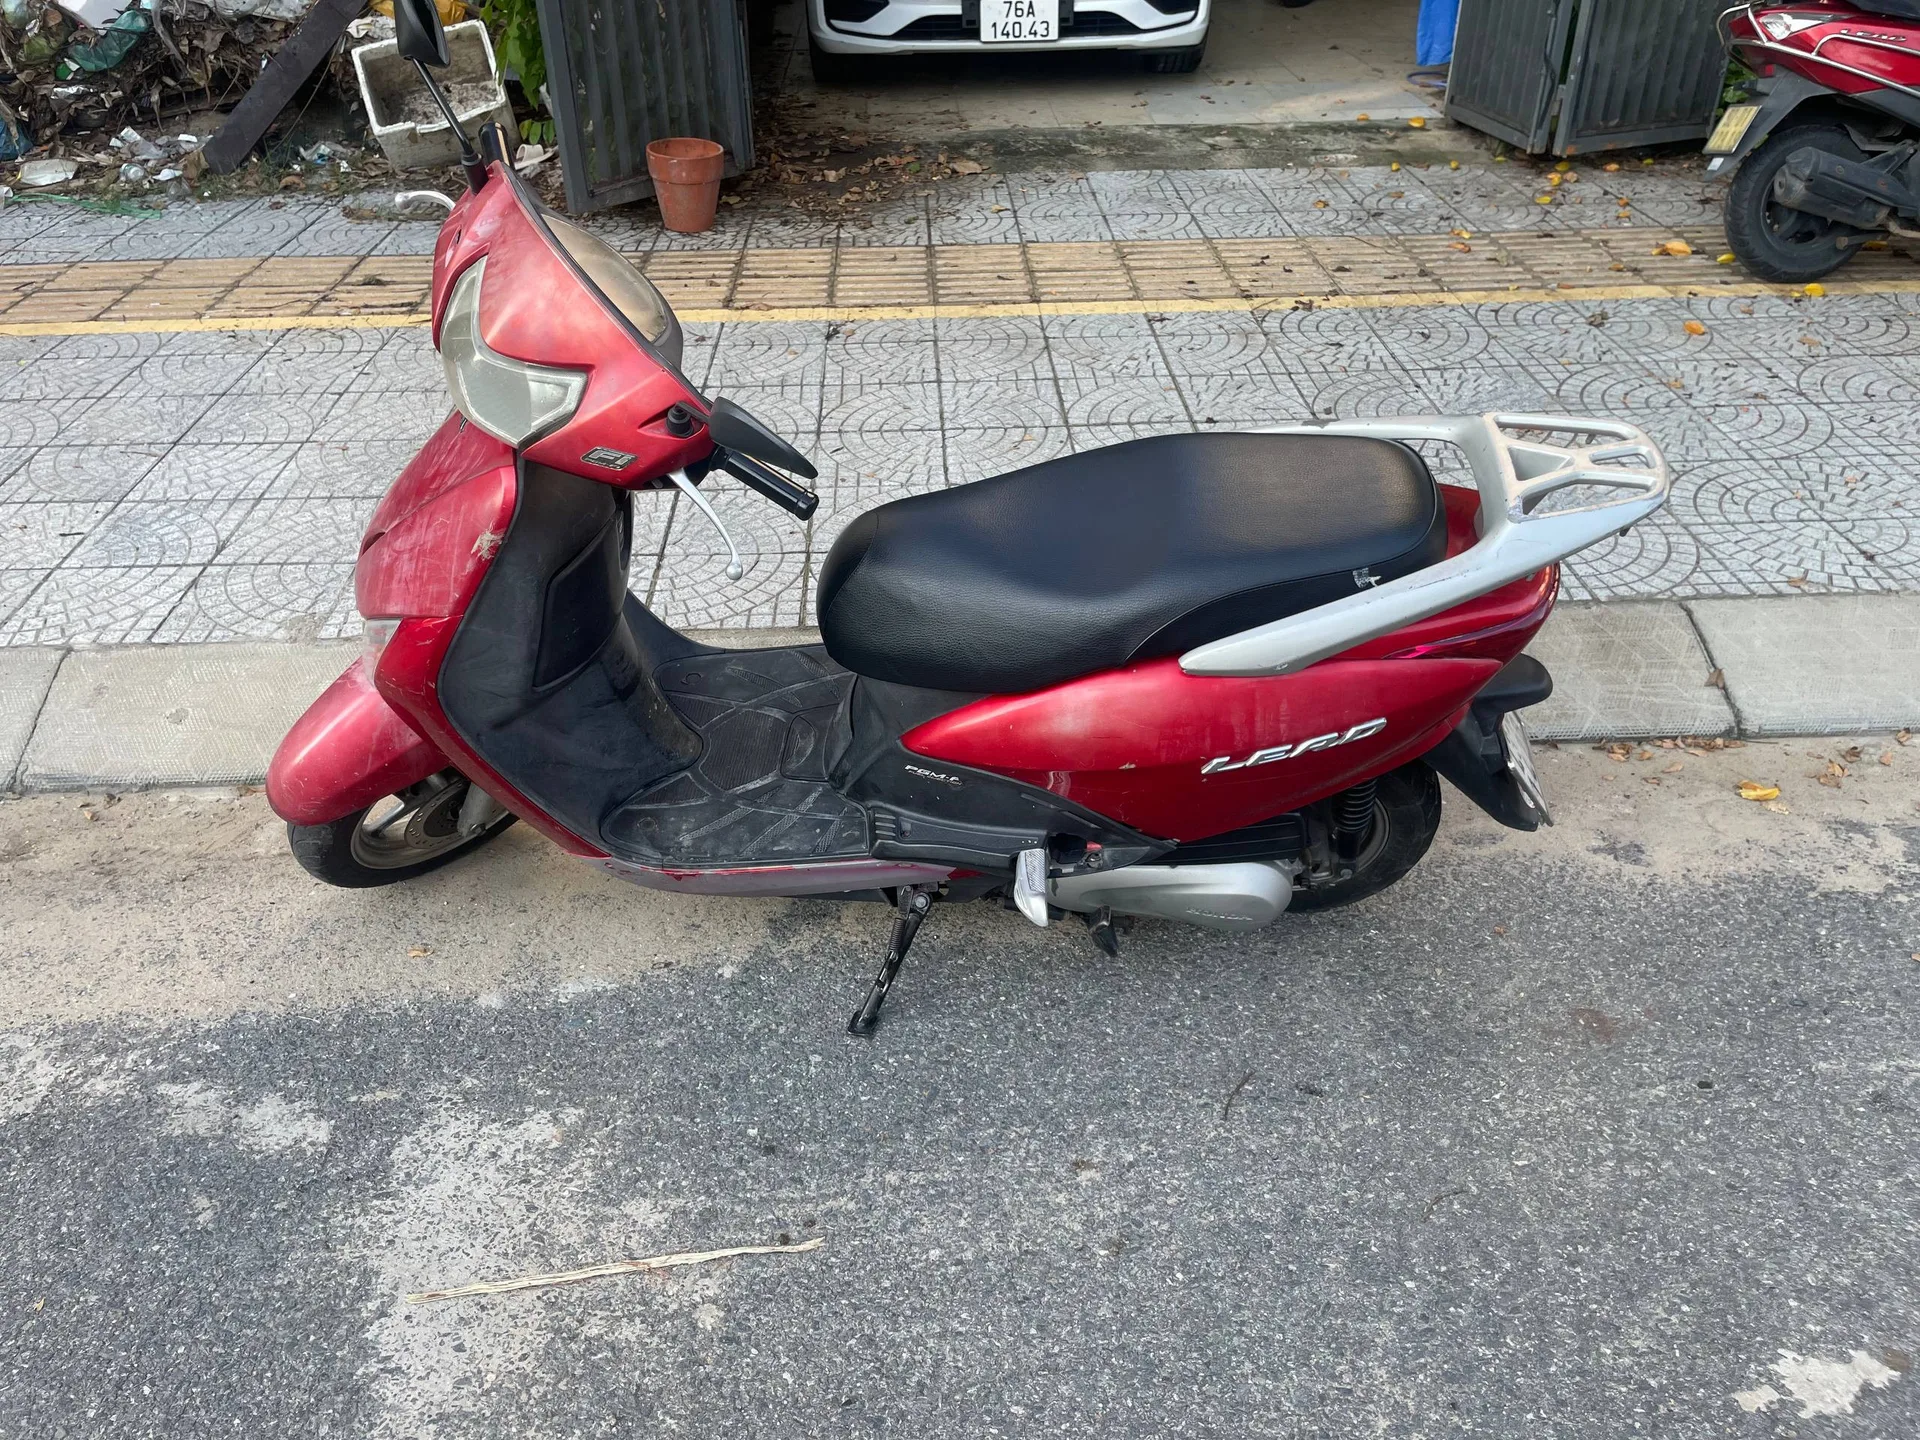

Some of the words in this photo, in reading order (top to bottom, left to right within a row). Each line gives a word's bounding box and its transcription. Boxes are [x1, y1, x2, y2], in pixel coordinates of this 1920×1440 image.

[1003, 0, 1036, 18] 76A
[991, 20, 1050, 39] 140.43
[1201, 717, 1388, 774] LEAD
